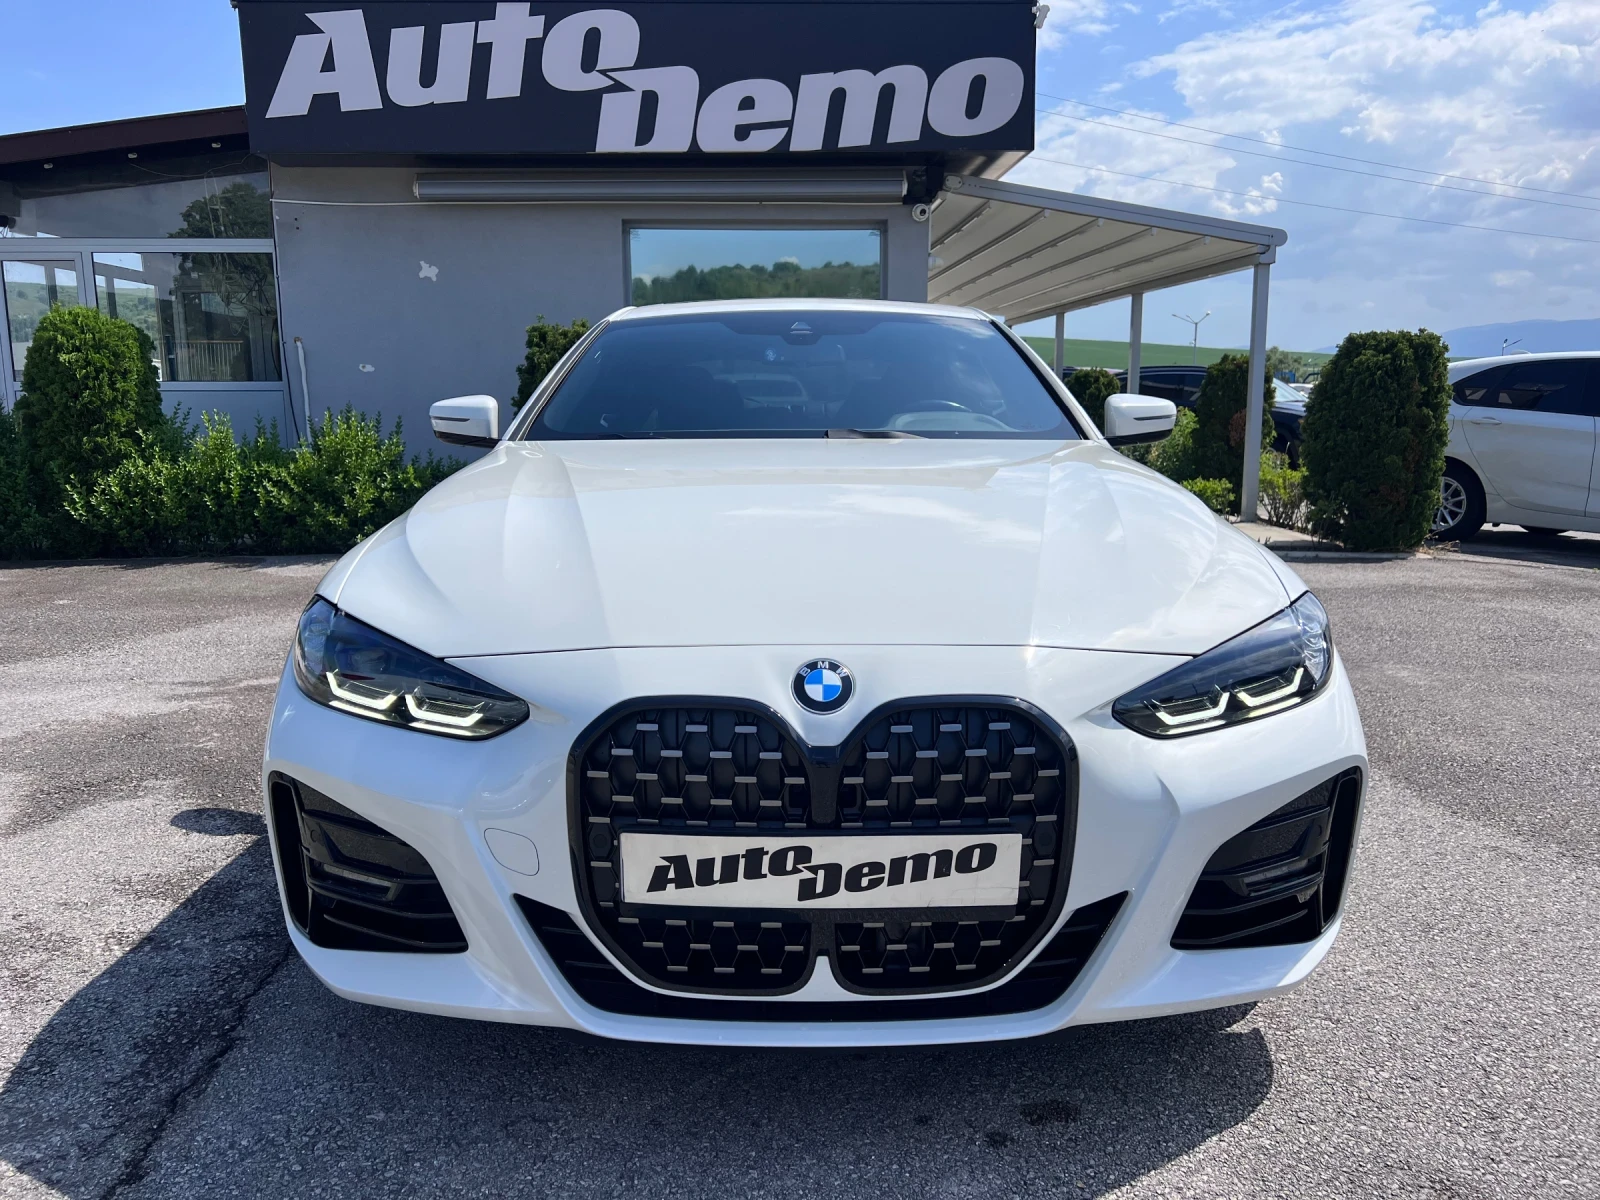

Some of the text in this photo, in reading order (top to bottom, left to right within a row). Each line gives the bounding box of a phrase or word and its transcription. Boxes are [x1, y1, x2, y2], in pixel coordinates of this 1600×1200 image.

[265, 2, 1025, 153] Auto Demo
[799, 660, 849, 678] BMW
[646, 842, 998, 902] Auto Demo
